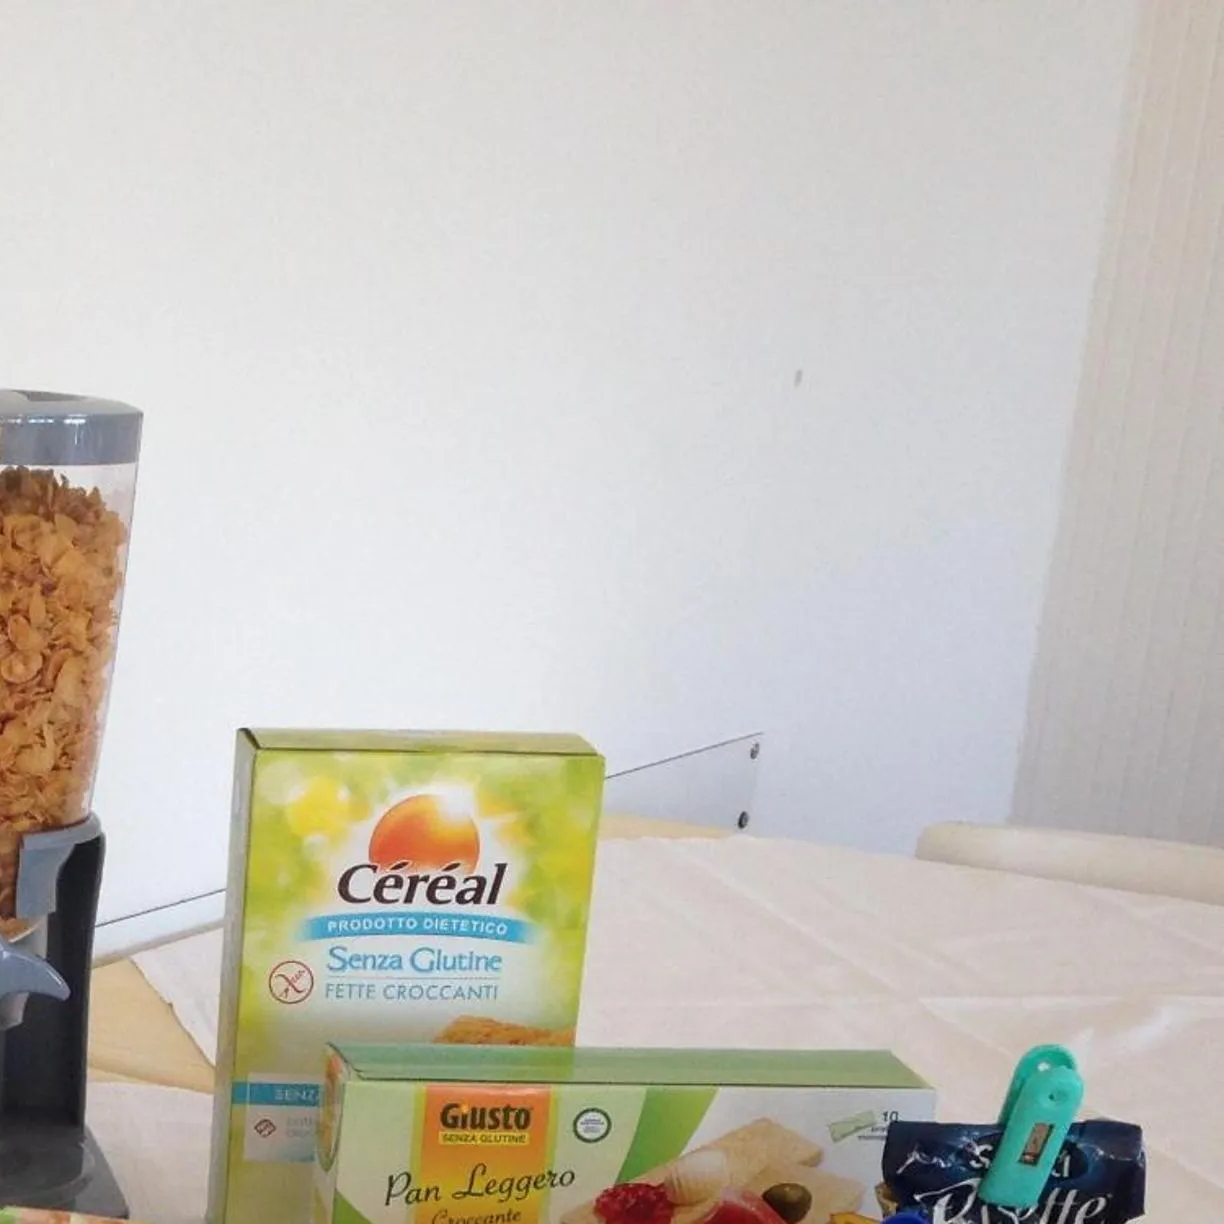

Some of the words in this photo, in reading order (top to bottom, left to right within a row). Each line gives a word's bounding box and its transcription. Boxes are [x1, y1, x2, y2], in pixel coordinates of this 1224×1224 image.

[336, 861, 508, 906] Céréal
[327, 916, 418, 933] PRODOTTO
[423, 916, 509, 936] DIETETICO
[325, 945, 404, 973] Senza
[409, 946, 503, 974] Glutine
[324, 982, 377, 1000] FETTE
[382, 984, 499, 1001] CROCCANTI
[440, 1103, 531, 1131] Giusto
[442, 1133, 477, 1145] SENZA
[479, 1133, 527, 1145] GLUTINE
[385, 1171, 442, 1207] Pan
[451, 1163, 577, 1204] Leggero
